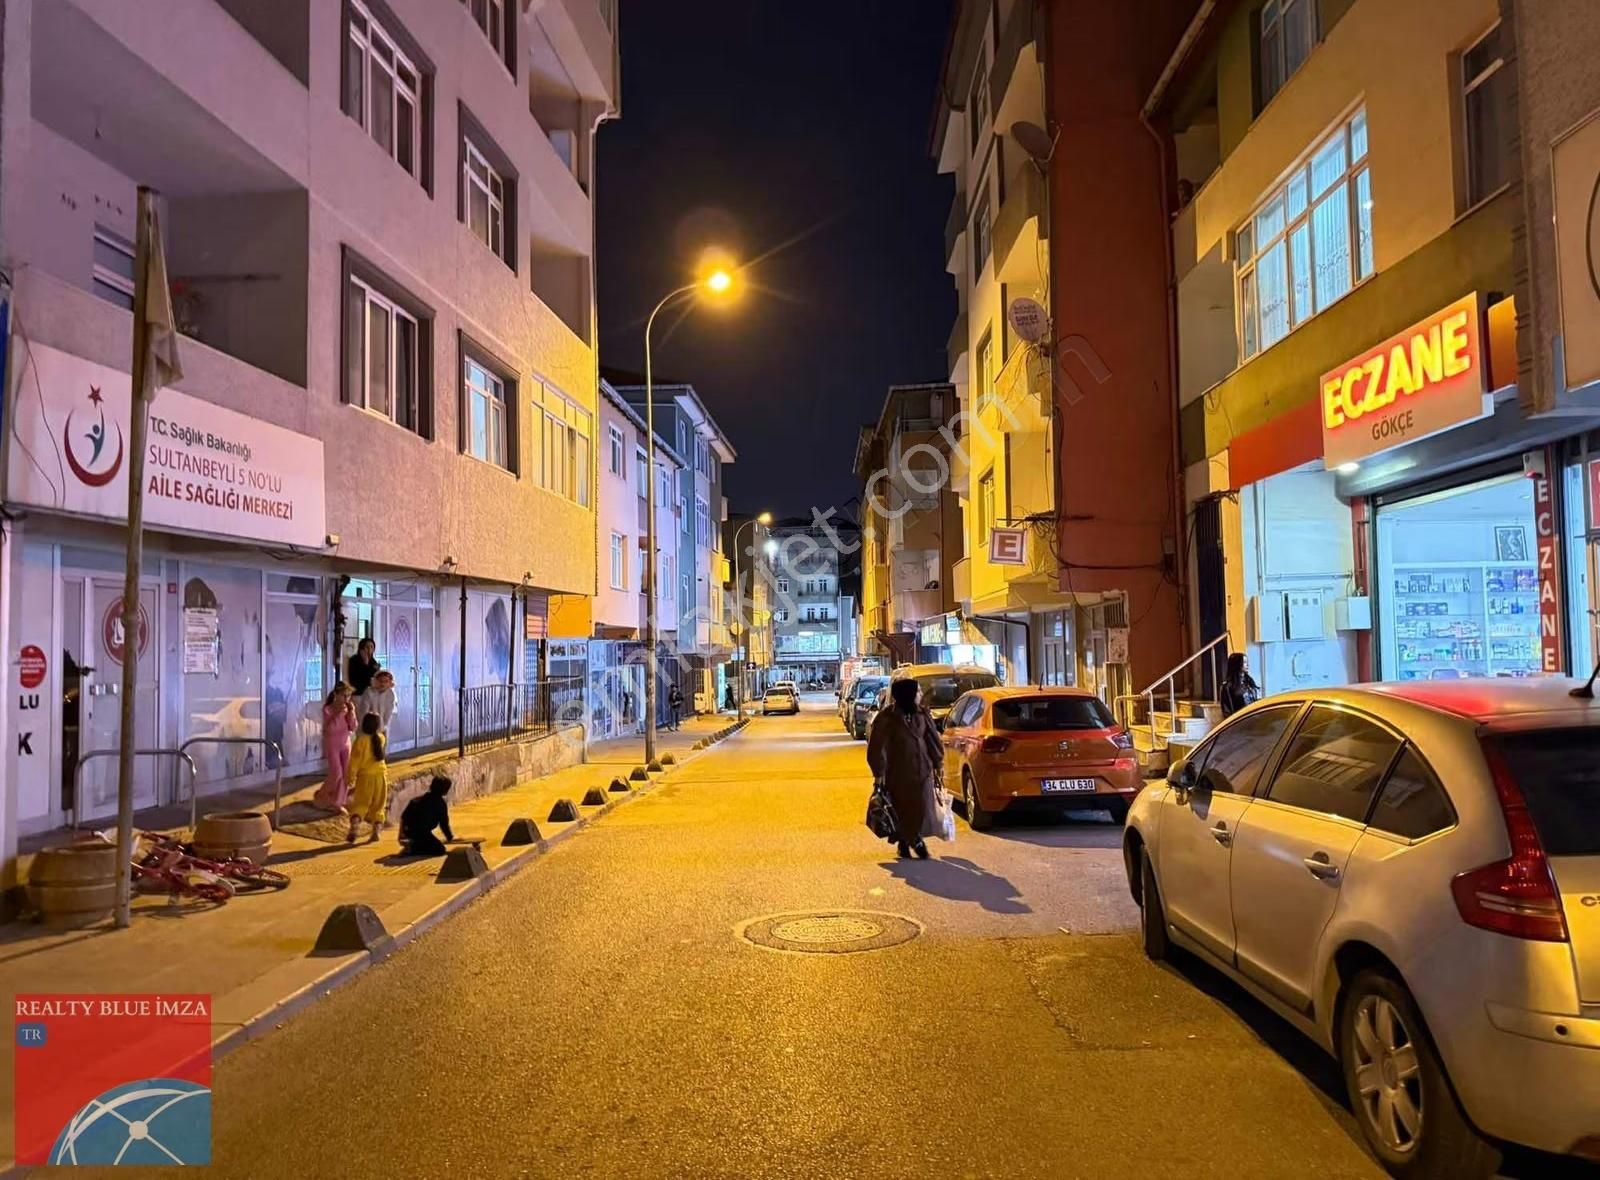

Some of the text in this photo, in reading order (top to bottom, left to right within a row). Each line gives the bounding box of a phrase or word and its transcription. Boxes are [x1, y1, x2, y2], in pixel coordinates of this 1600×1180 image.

[1323, 310, 1471, 429] ECZANE
[170, 422, 204, 447] Sağlık
[206, 433, 252, 463] Bakanlığı
[1371, 410, 1414, 440] GÖKÇE
[149, 444, 235, 483] SULTANBEYLİ
[238, 468, 245, 486] 5
[148, 473, 293, 520] AİLE SAĞLIĞI MERKEZİ
[997, 534, 1018, 558] E
[1537, 479, 1556, 671] ECZANE
[19, 694, 39, 710] LU
[18, 732, 33, 756] K
[1045, 780, 1094, 790] 34 CLU 630
